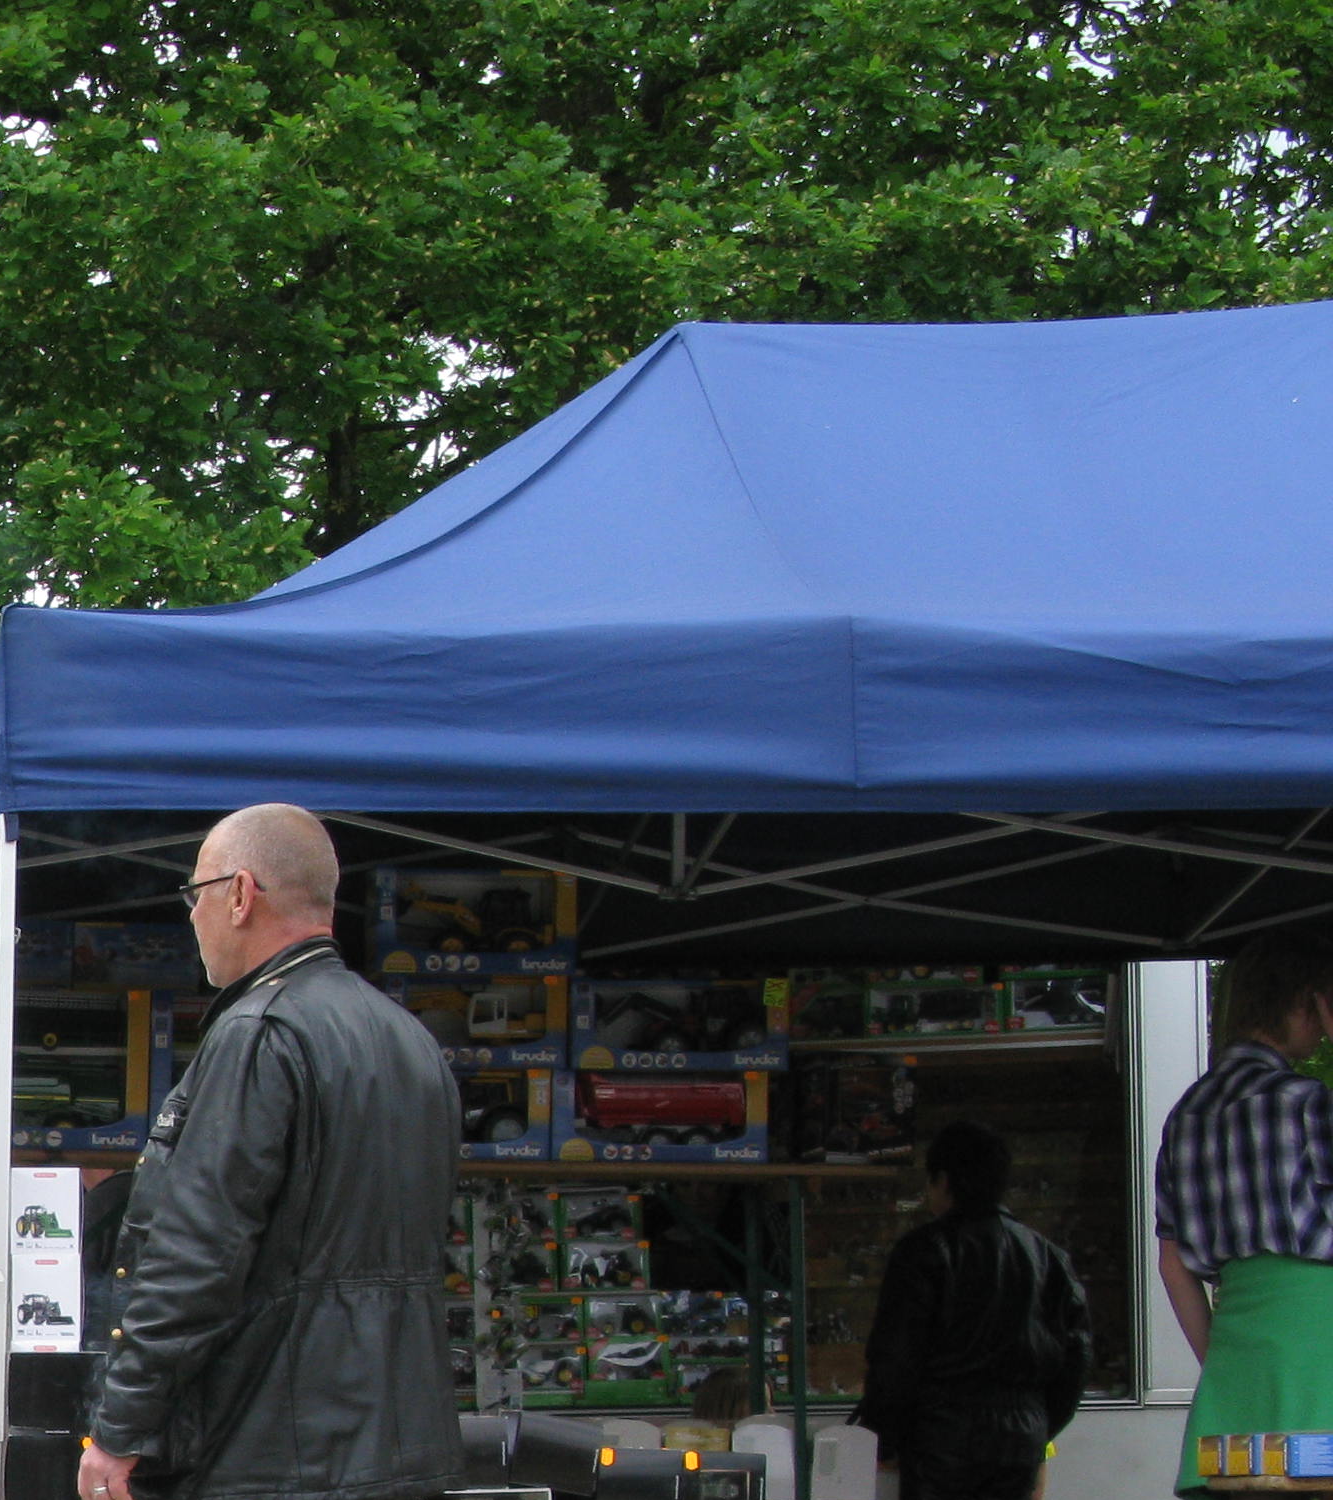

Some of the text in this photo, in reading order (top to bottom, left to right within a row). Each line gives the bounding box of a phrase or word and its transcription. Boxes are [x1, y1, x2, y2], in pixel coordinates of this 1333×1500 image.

[521, 957, 567, 970] bruder
[511, 1049, 558, 1062] bruder
[735, 1053, 780, 1065] bruder
[91, 1132, 137, 1146] bruder
[495, 1143, 542, 1157] bruder
[715, 1146, 761, 1159] bruder
